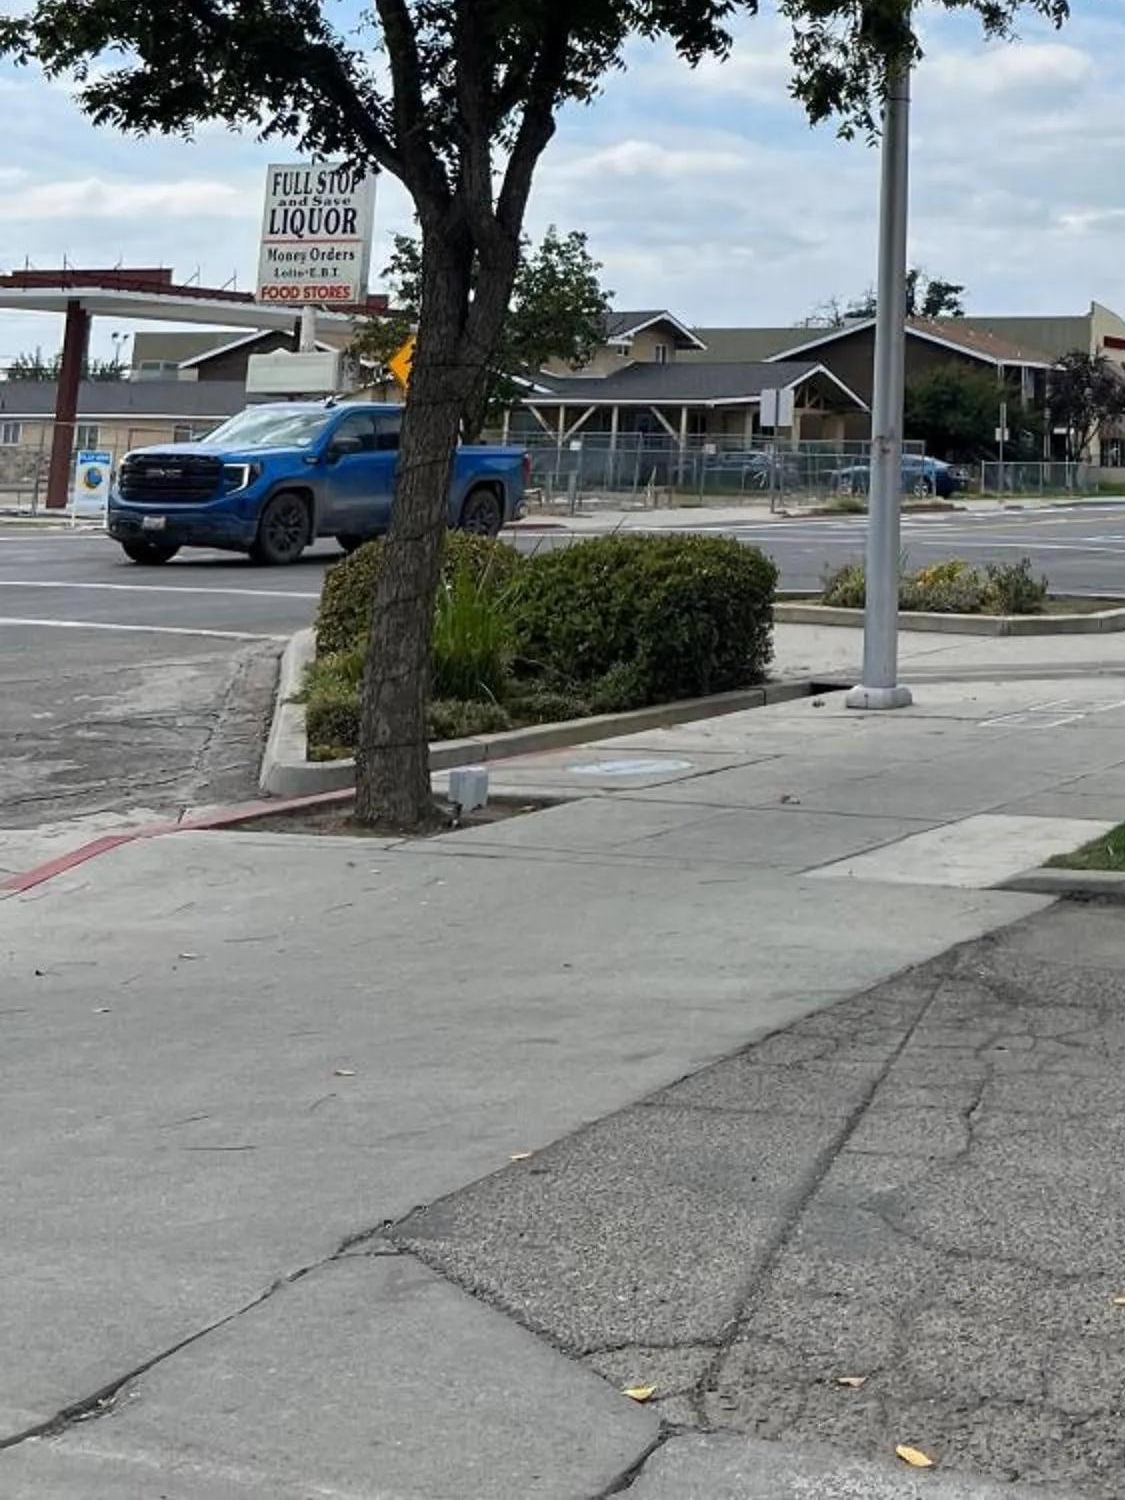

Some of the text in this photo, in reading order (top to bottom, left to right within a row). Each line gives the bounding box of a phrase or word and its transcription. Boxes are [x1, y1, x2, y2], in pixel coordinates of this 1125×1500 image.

[272, 170, 361, 197] FULL STOP
[277, 195, 351, 207] and Save
[268, 207, 358, 239] LIQUOR
[267, 247, 355, 264] Money Orders
[261, 285, 352, 299] FOOD STORES
